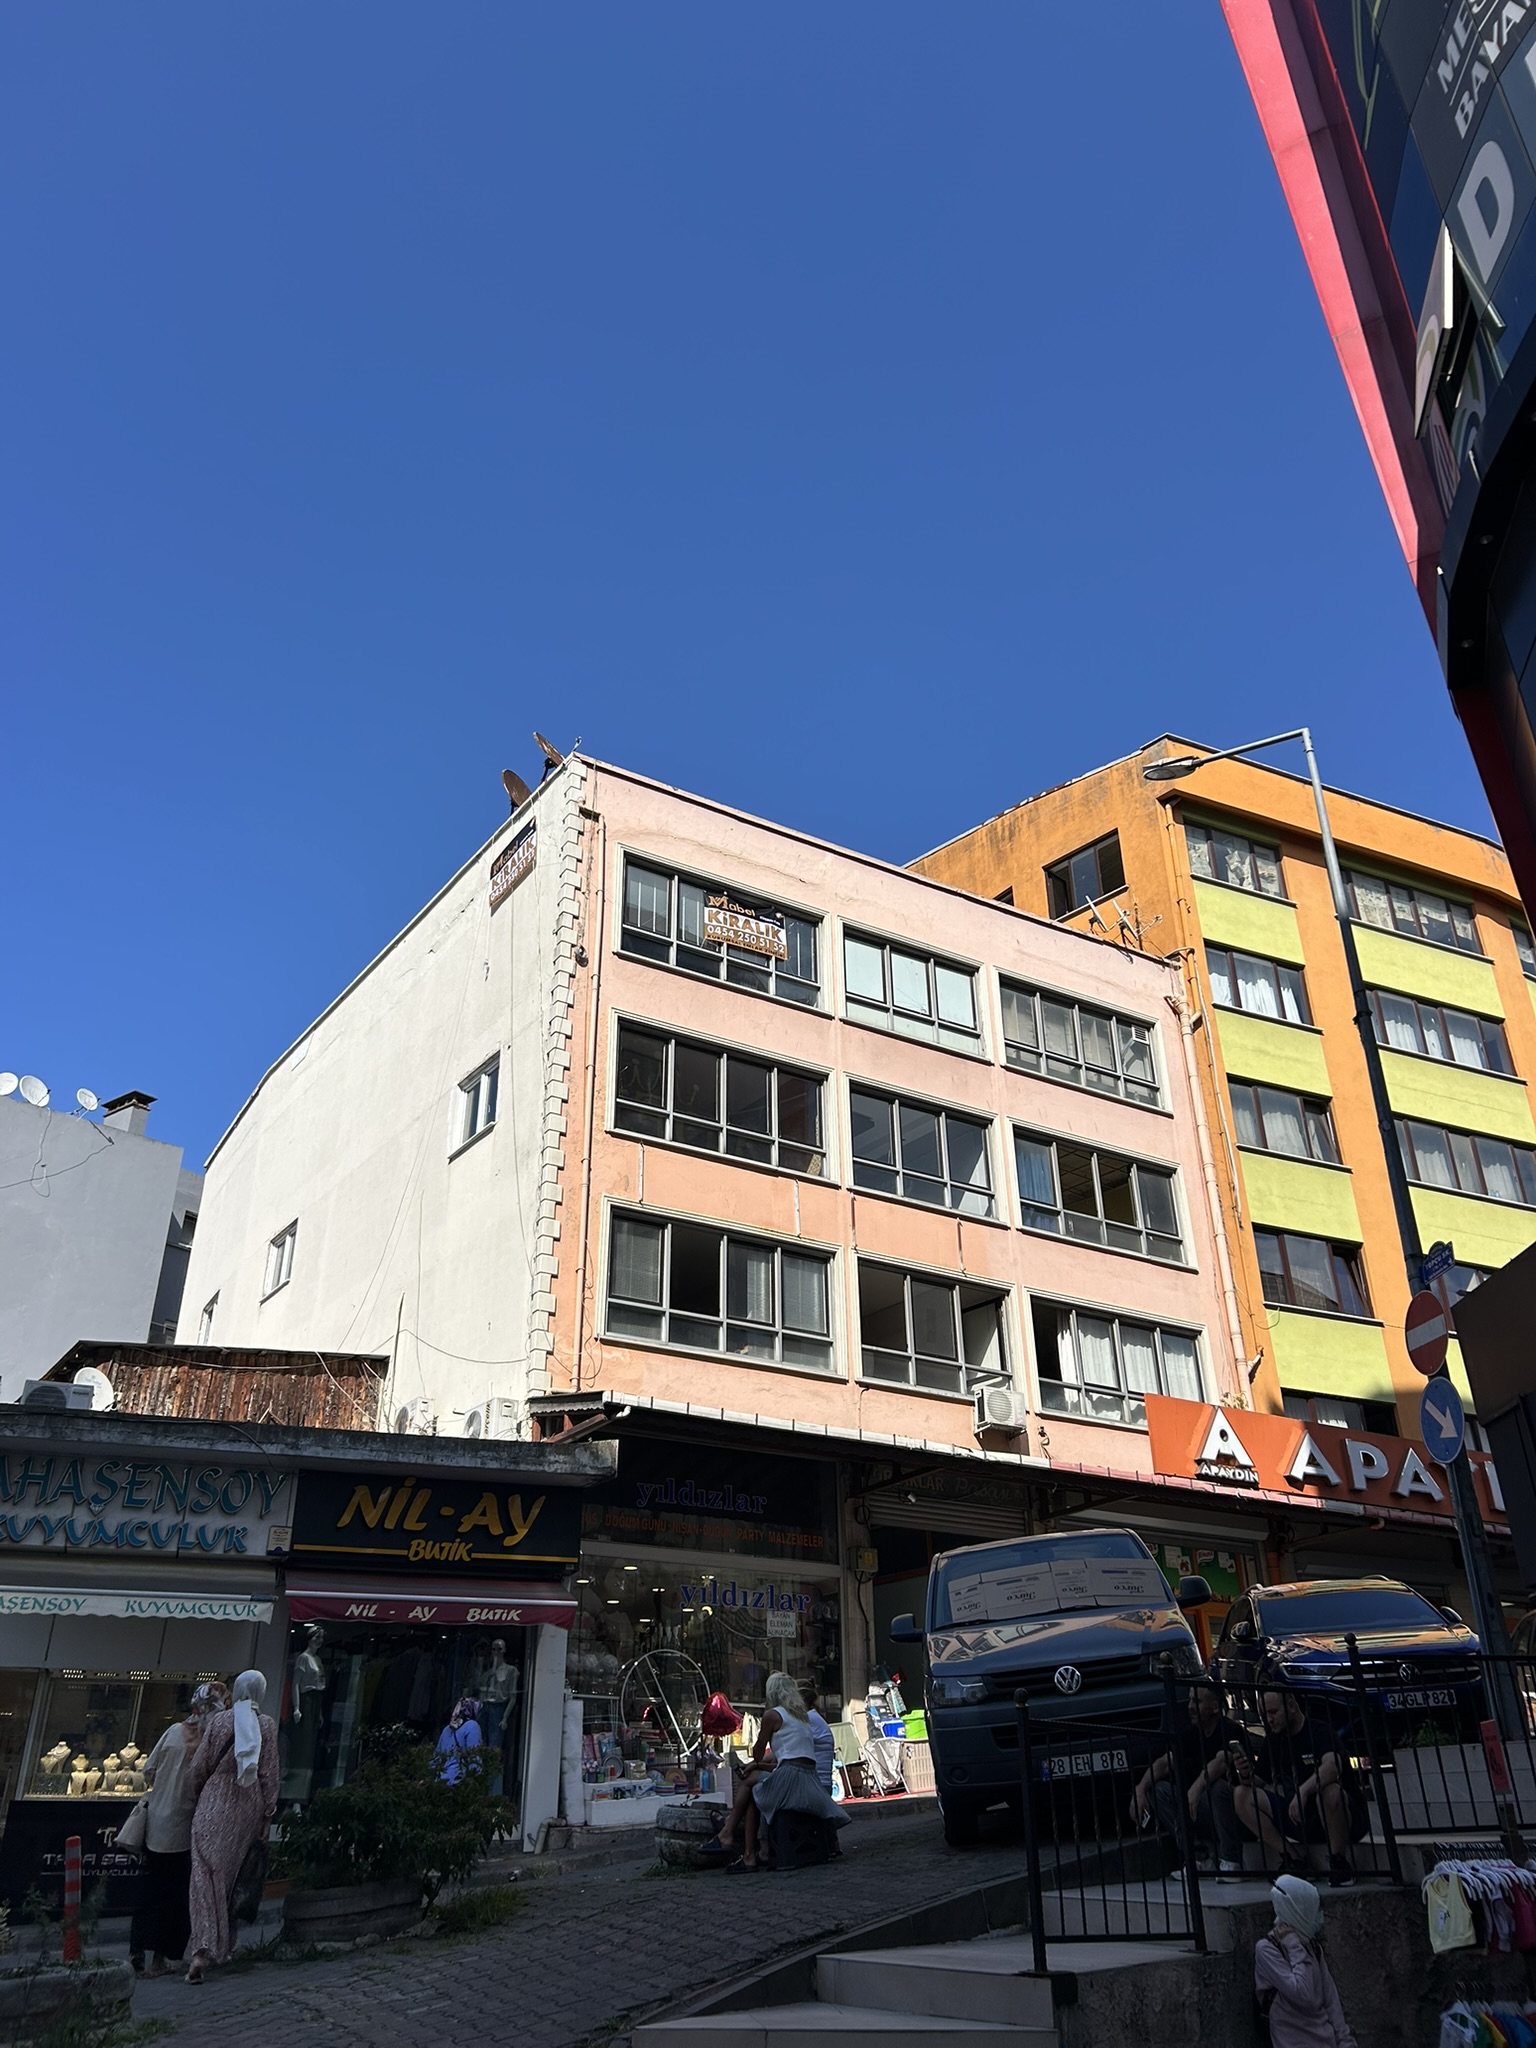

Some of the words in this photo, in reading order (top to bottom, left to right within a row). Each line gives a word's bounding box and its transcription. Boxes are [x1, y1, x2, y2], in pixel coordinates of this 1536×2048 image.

[1454, 0, 1531, 139] BAYA
[707, 925, 735, 939] 0454
[737, 930, 757, 944] 250
[759, 938, 770, 948] 51
[773, 942, 785, 953] 52
[1200, 1464, 1259, 1483] APAYDIN
[1285, 1430, 1506, 1512] APA
[635, 1478, 768, 1514] yıldızlar
[735, 1527, 765, 1543] PARTY
[680, 1580, 811, 1613] yıldızlar
[125, 1599, 258, 1618] KUYUMCULUK
[769, 1620, 794, 1628] ELEMAN
[1389, 1694, 1405, 1707] 34
[1050, 1758, 1066, 1774] 28
[1073, 1755, 1091, 1771] EH
[42, 1852, 96, 1866] TAA
[101, 1853, 147, 1867] SEN
